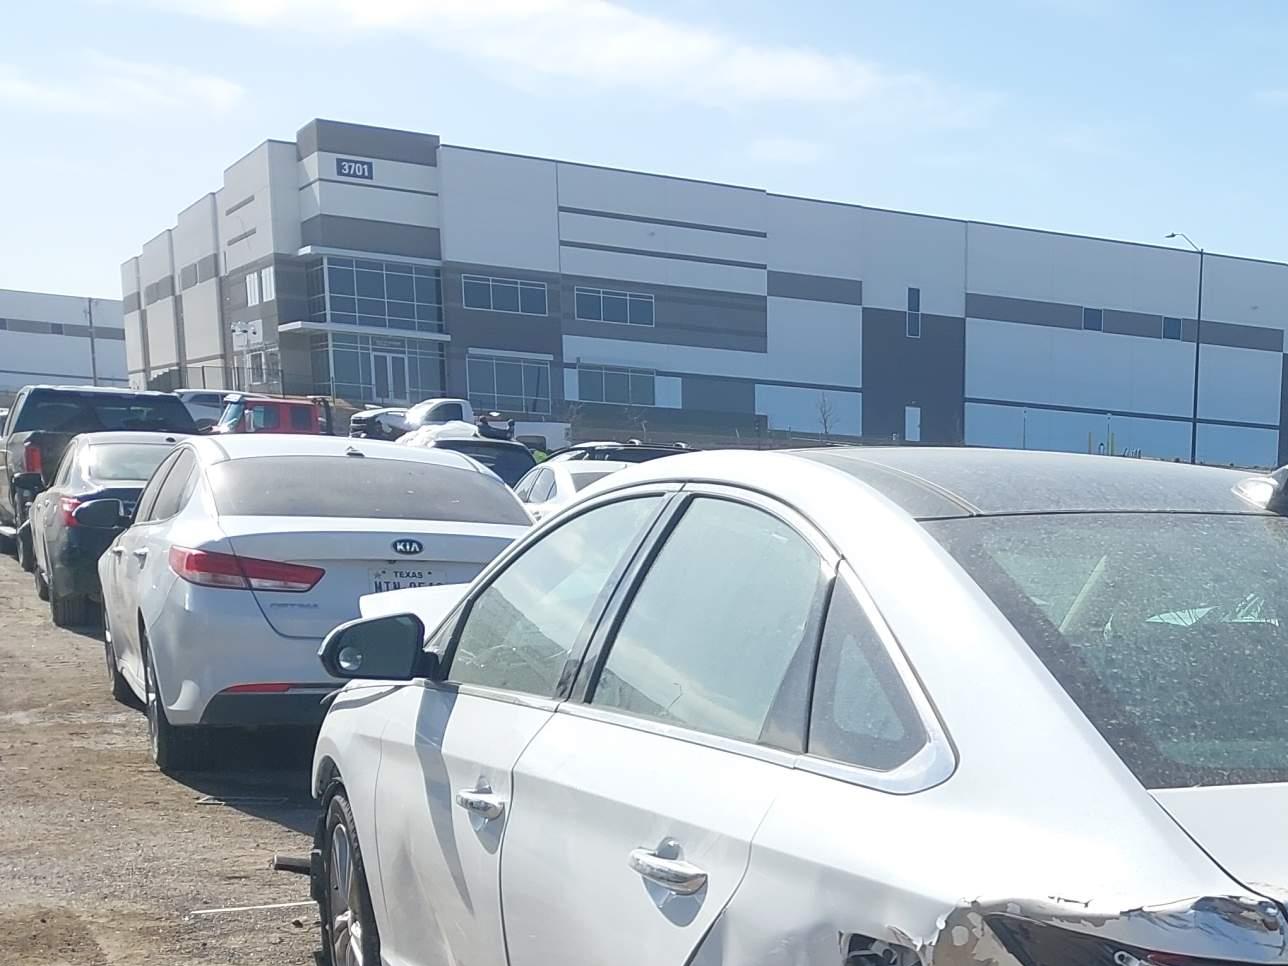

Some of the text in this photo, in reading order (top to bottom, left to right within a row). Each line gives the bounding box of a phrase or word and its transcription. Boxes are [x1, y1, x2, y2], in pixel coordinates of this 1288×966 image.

[341, 161, 369, 176] 3701
[396, 542, 420, 552] KIA
[394, 570, 423, 579] TEXAS
